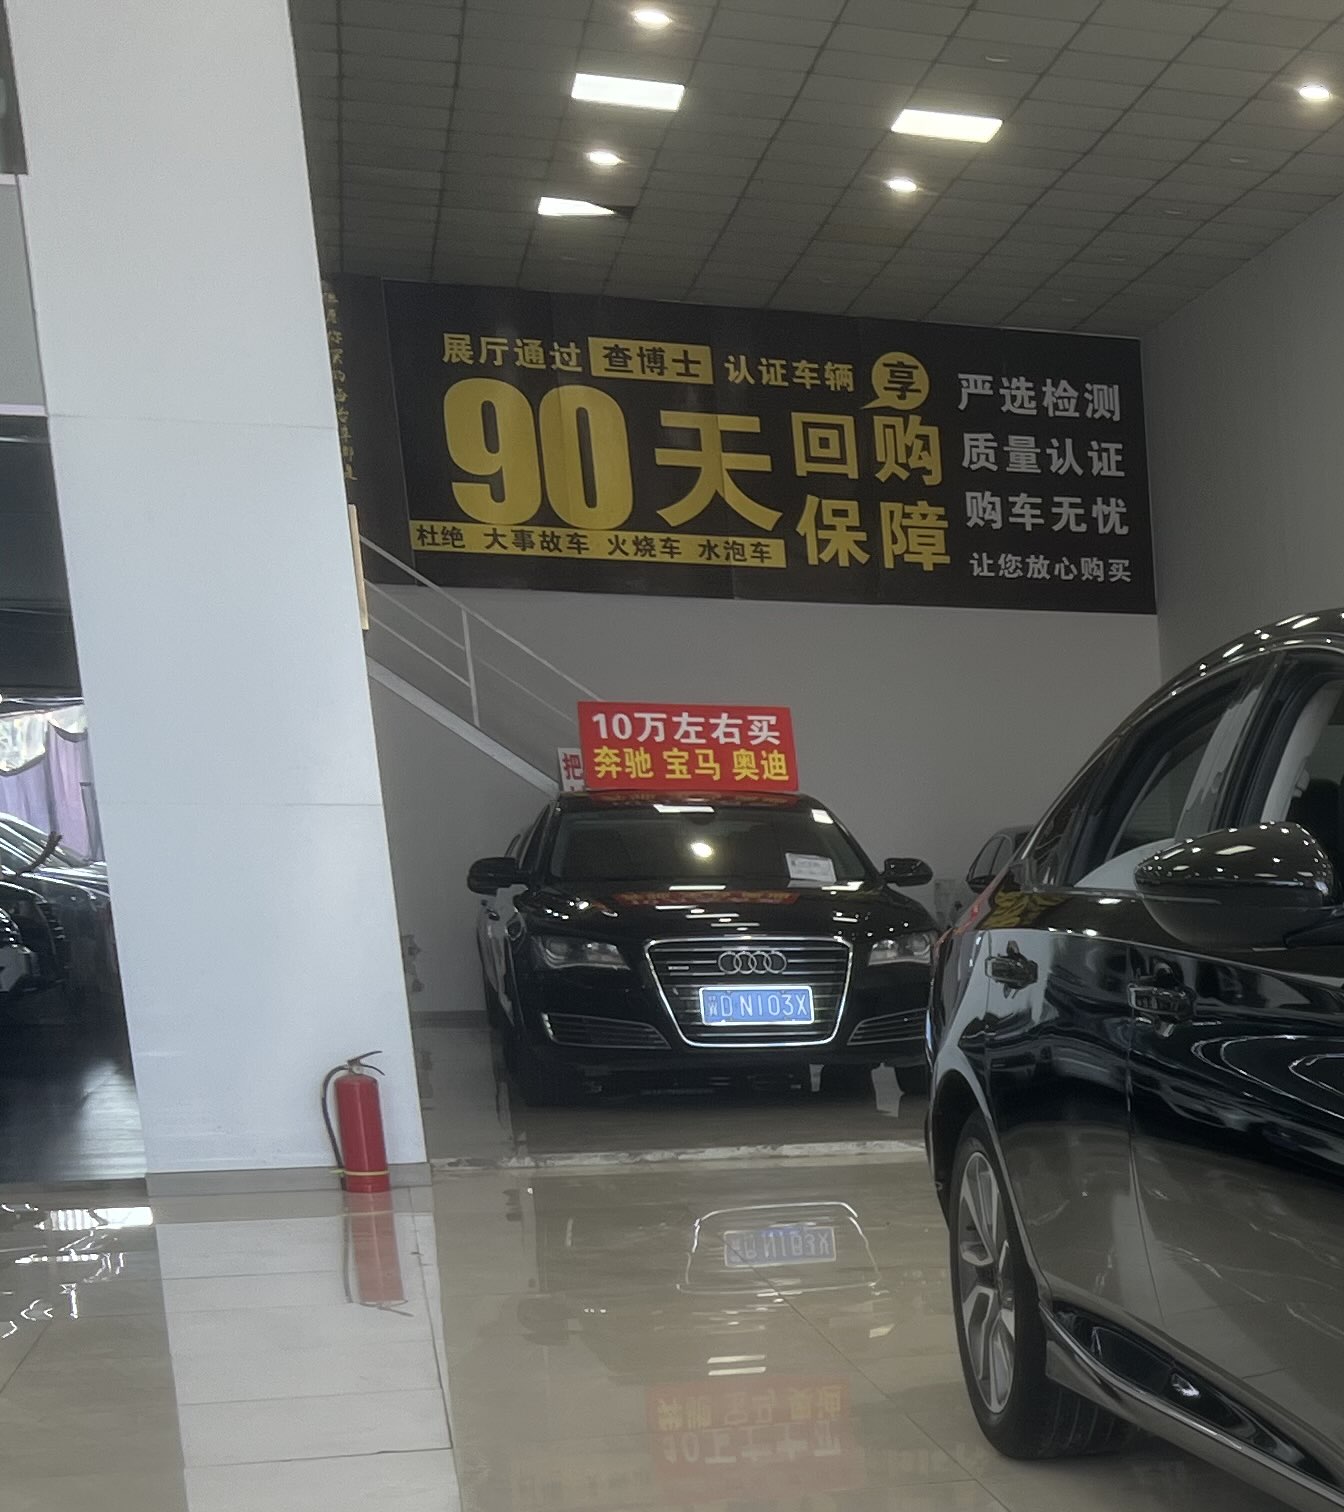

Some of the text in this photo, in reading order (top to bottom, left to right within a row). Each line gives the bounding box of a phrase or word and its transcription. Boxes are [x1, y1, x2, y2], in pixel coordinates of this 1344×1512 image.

[442, 333, 922, 401] 展厅通过 查博士 认证车辆 享
[957, 372, 1122, 422] 严选检测
[790, 412, 944, 487] 回购
[961, 431, 1126, 478] 质量认证
[796, 494, 951, 572] 保障
[965, 491, 1130, 536] 购车无忧
[416, 524, 773, 564] 杜绝 大事故车 火烧车 水泡车
[969, 553, 1132, 583] 让您放心购买
[591, 711, 780, 746] 10万左右买
[594, 746, 790, 782] 奔驰 宝马 奥迪
